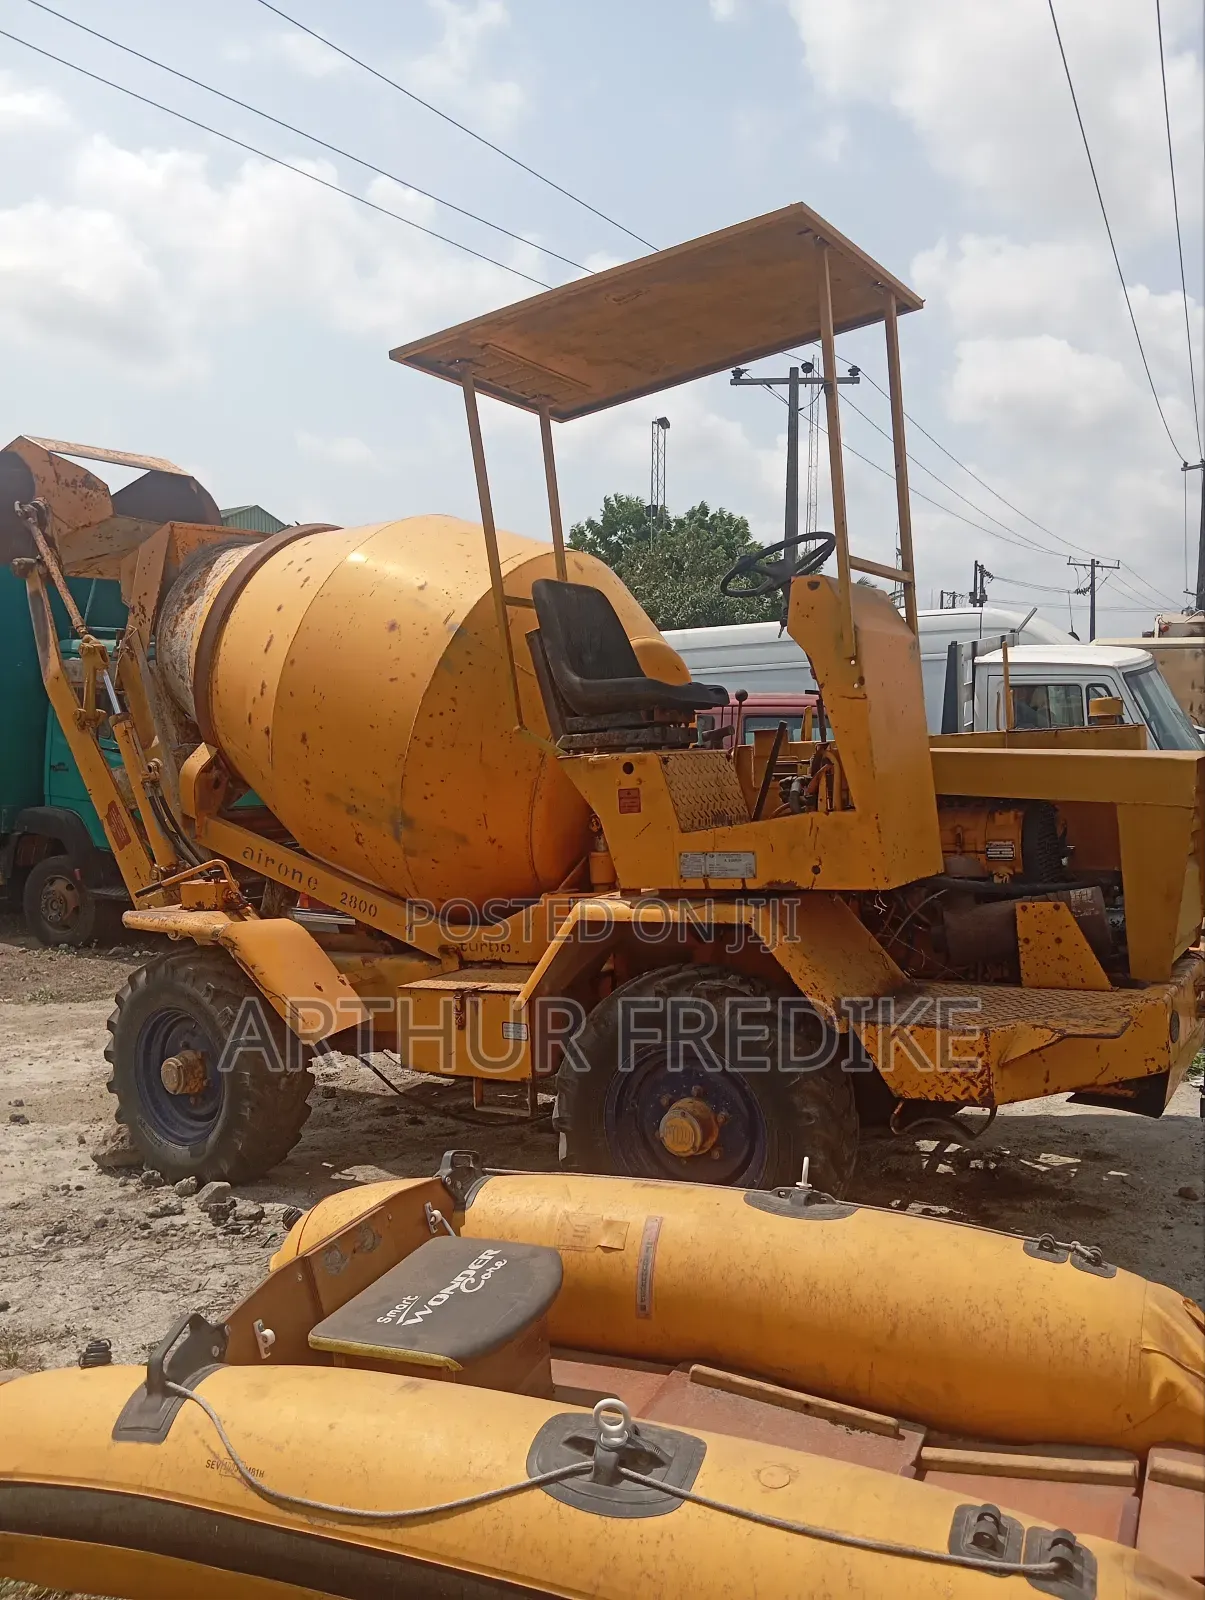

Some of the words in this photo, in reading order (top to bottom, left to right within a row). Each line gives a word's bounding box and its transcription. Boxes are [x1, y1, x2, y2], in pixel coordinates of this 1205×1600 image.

[242, 846, 318, 890] airone
[340, 891, 378, 917] 2800
[396, 1249, 502, 1326] WONDER
[460, 1259, 508, 1293] Core
[377, 1295, 420, 1324] Smart
